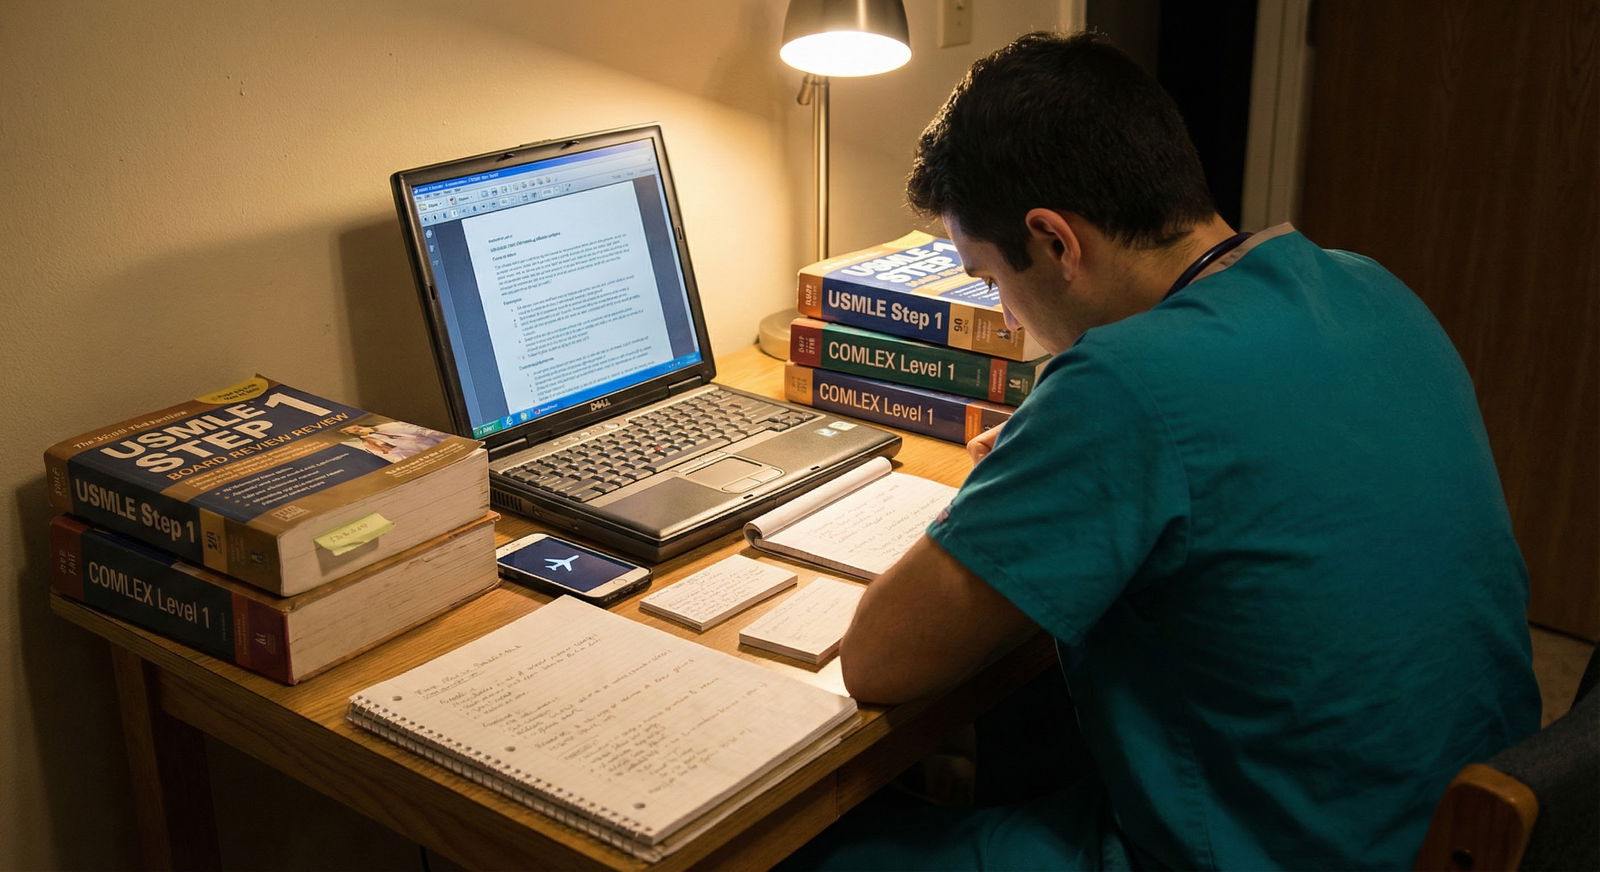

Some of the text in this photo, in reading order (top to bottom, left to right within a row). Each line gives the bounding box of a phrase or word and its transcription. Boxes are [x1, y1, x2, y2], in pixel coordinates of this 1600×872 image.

[840, 247, 941, 277] USMLE
[875, 256, 957, 283] STEP
[828, 289, 887, 318] USMLE
[891, 302, 929, 330] Step
[934, 312, 943, 330] 1
[828, 341, 896, 370] COMLEX
[900, 352, 941, 378] Level
[947, 363, 955, 381] 1
[590, 399, 611, 411] DELL
[819, 382, 880, 413] COMLEX
[884, 397, 922, 421] Level
[927, 408, 934, 425] 1
[100, 403, 266, 459] USMLE
[264, 392, 333, 417] 1
[135, 420, 274, 473] STEP
[166, 456, 228, 481] BOARD
[228, 433, 292, 459] REVIEW
[291, 412, 349, 436] REVIEW
[74, 478, 137, 521] USMLE
[141, 502, 182, 541] Step
[186, 520, 195, 543] 1
[88, 561, 154, 607] COMLEX
[158, 588, 197, 624] Level
[202, 607, 210, 628] 1
